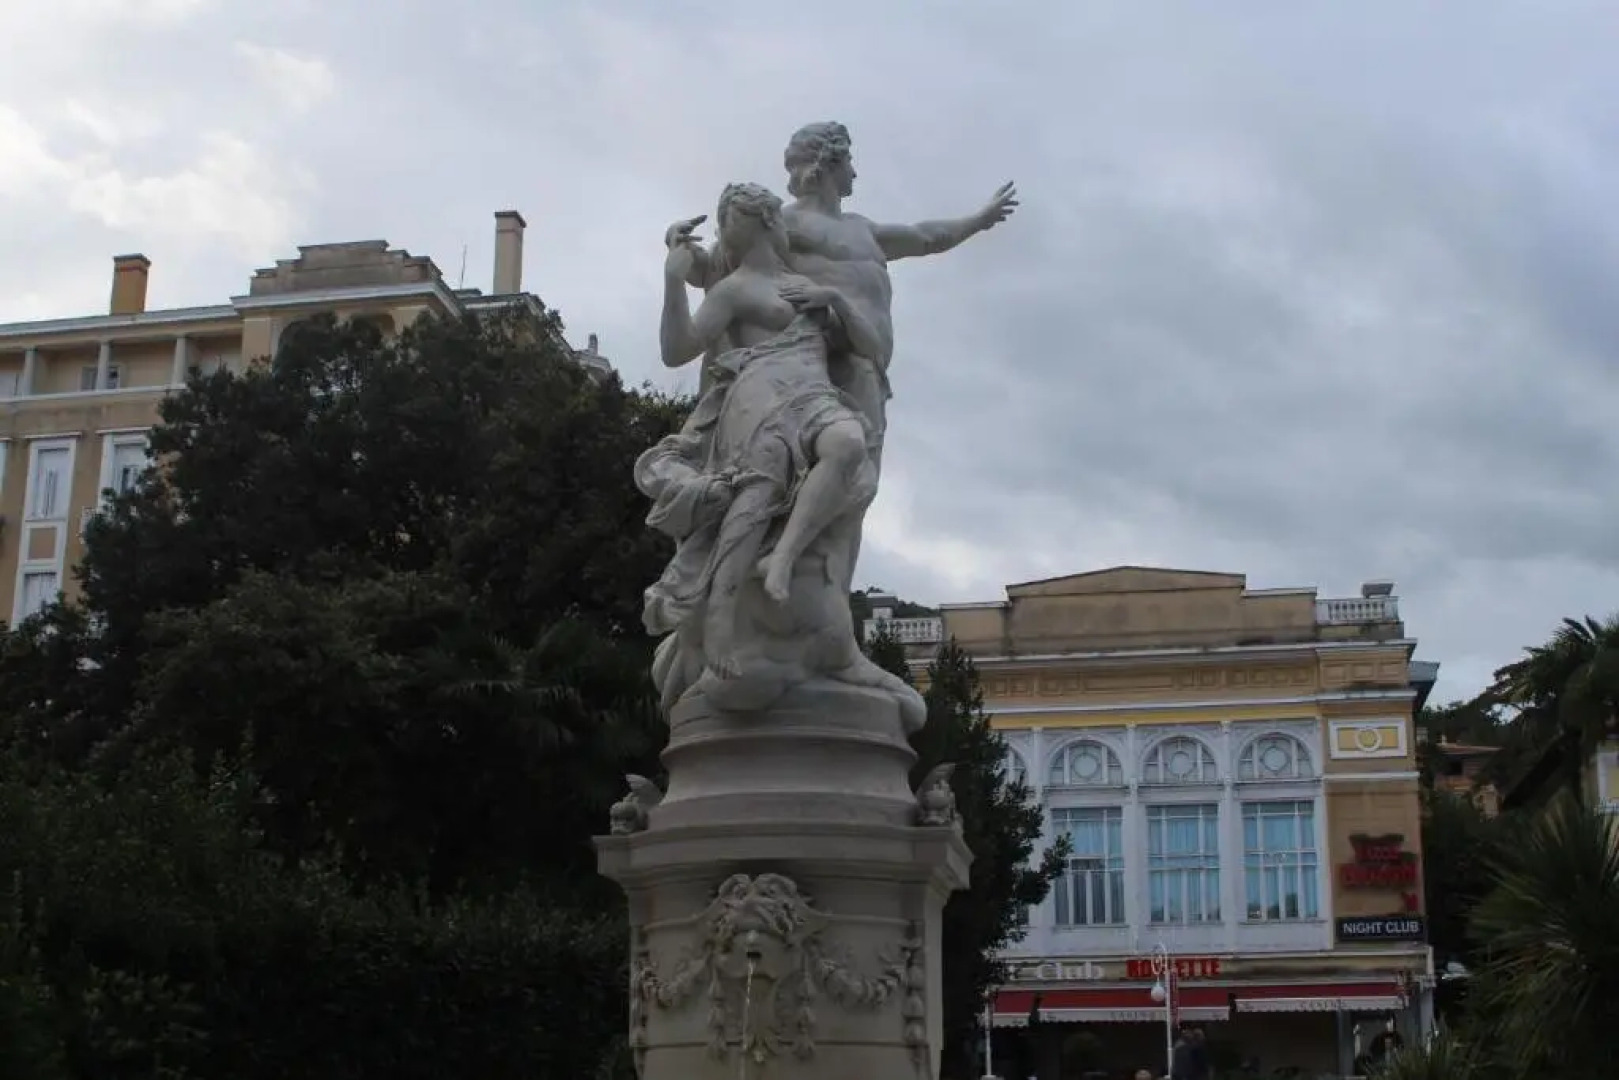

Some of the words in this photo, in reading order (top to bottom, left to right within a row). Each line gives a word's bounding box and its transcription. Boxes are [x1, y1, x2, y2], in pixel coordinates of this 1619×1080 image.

[1343, 922, 1382, 935] NIGHT
[1385, 920, 1419, 934] CLUB
[1036, 962, 1105, 980] Club
